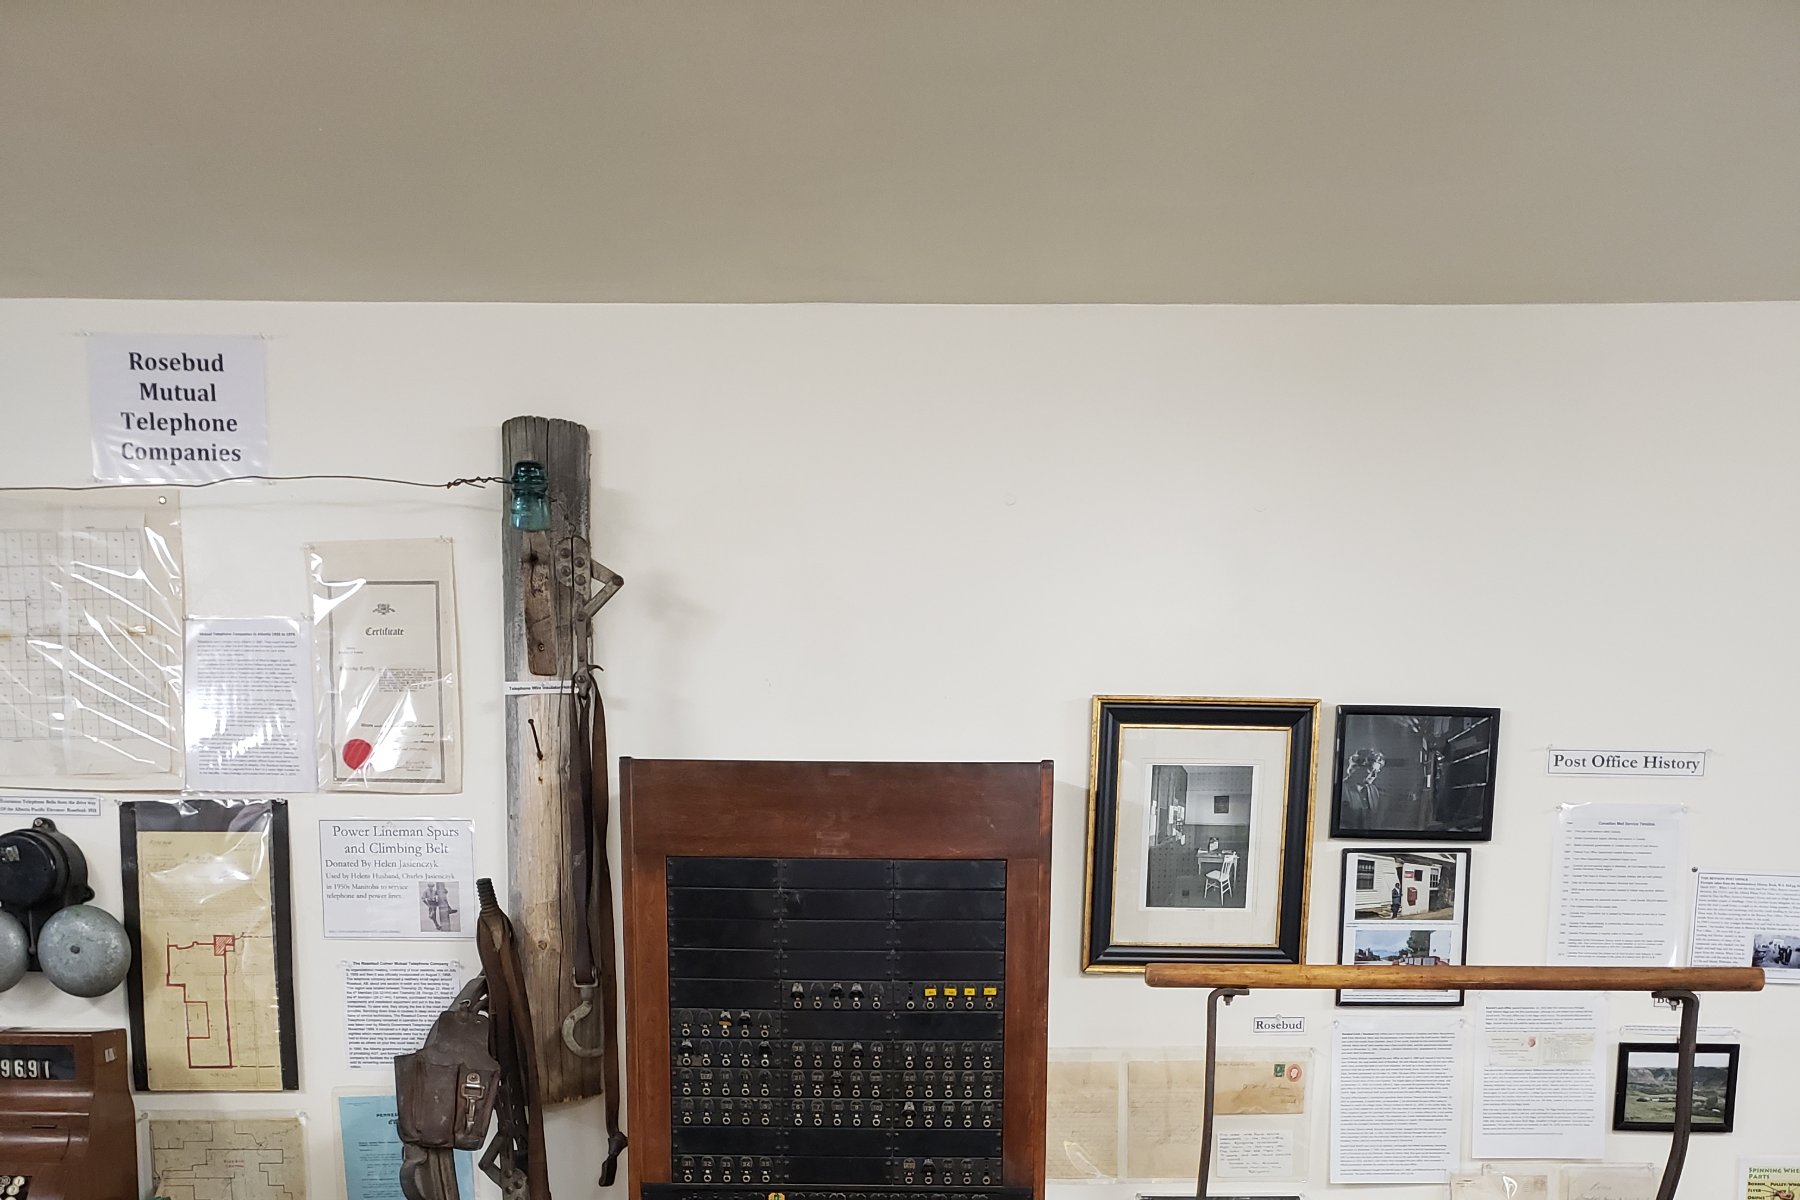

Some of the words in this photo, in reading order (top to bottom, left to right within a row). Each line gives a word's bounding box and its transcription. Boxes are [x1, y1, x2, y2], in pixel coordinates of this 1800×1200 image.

[128, 352, 224, 372] Rosebud
[140, 382, 216, 402] Mutual
[120, 412, 238, 436] Telephone
[122, 442, 242, 465] Companies
[366, 627, 404, 636] Certificate
[1554, 754, 1586, 767] Post
[1592, 755, 1638, 768] Office
[1643, 756, 1700, 773] History
[333, 826, 369, 836] Power
[373, 826, 423, 836] Lineman
[427, 826, 459, 840] Spurs
[344, 843, 365, 854] and
[370, 842, 422, 856] Climbing
[426, 843, 448, 854] Belt
[362, 860, 371, 869] By
[1256, 1020, 1302, 1030] Rosebud
